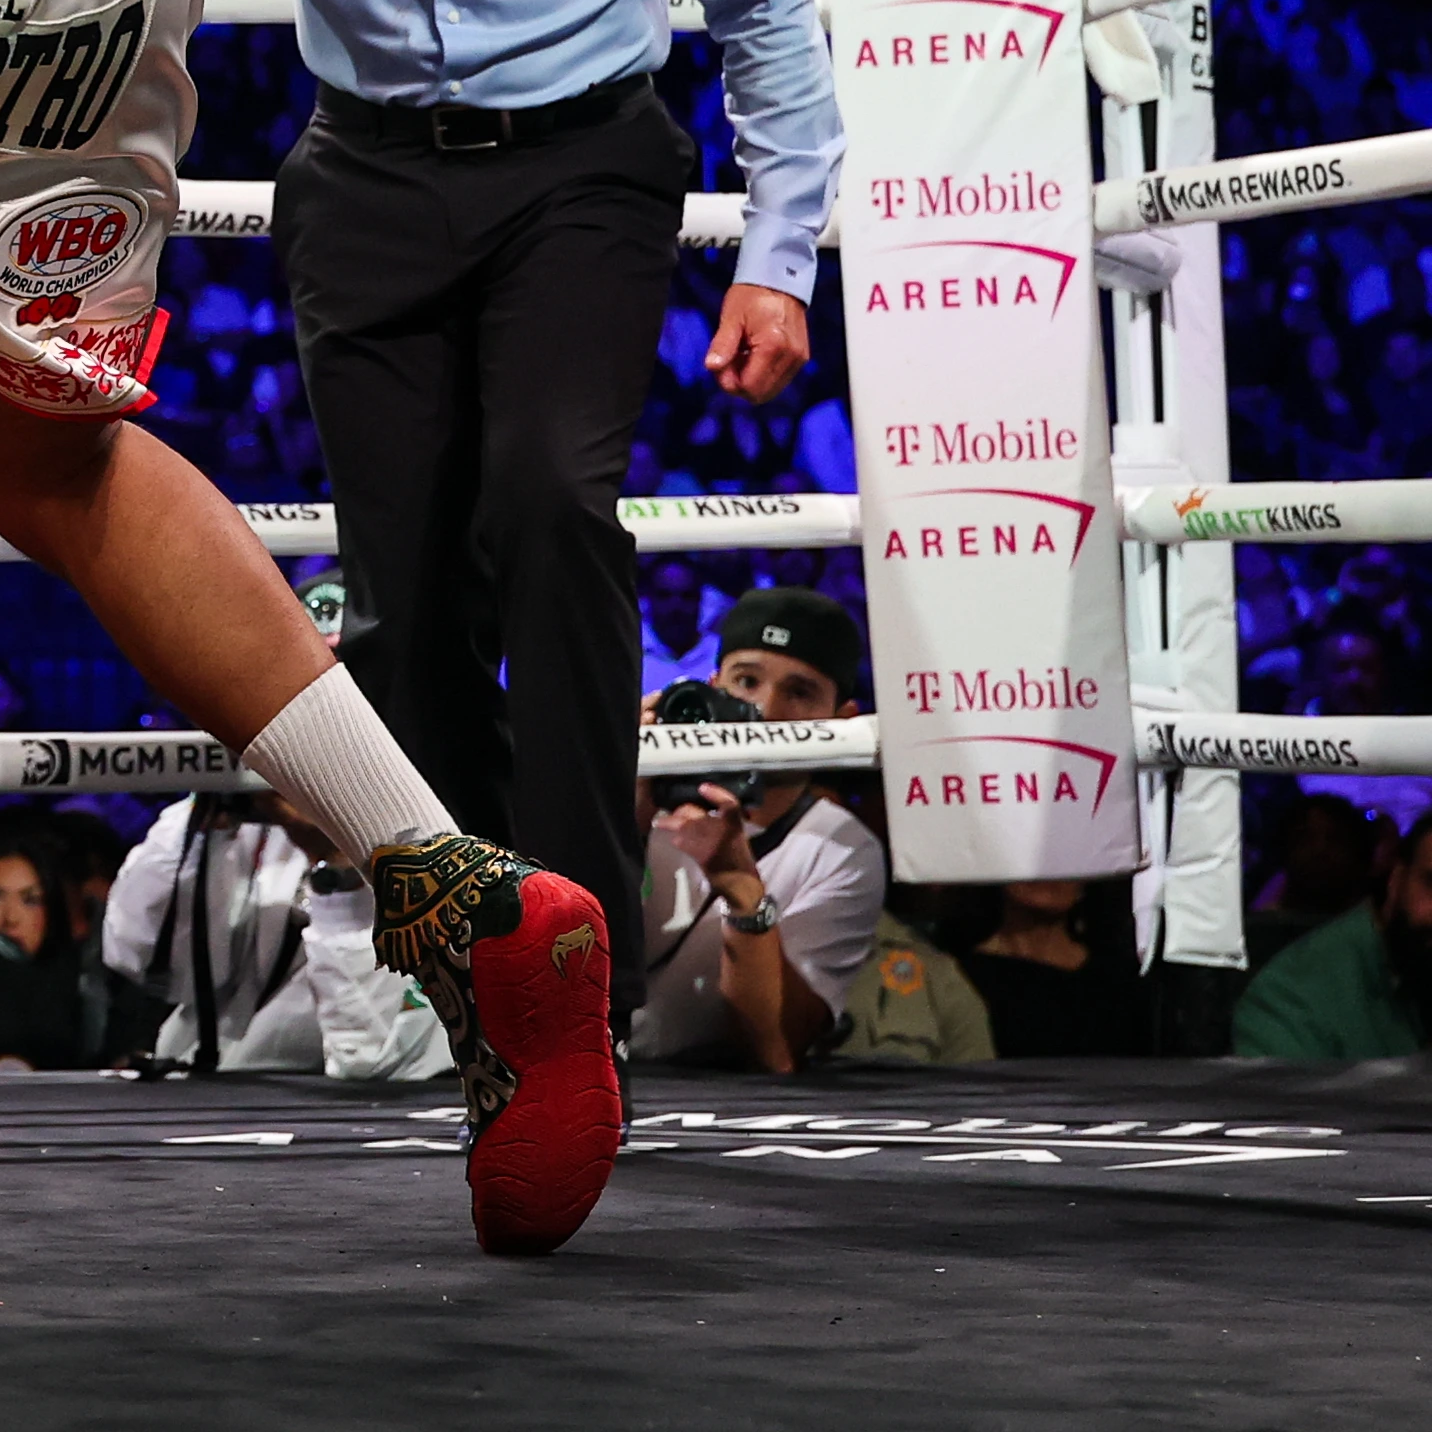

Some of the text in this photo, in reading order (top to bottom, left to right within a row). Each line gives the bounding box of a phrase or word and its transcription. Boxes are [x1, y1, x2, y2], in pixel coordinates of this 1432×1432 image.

[856, 30, 1024, 69] ARENA
[915, 171, 1062, 217] Mobile
[1168, 160, 1345, 212] MGM REWARDS
[17, 212, 128, 266] WBO
[0, 250, 120, 294] WORLD CHAMPION
[866, 274, 1036, 314] ARENA
[931, 418, 1078, 465] Mobile
[884, 523, 1056, 560] ARENA
[1183, 504, 1342, 540] DRAFTKINGS
[952, 667, 1099, 713] Mobile
[79, 746, 165, 775] MGM
[1179, 738, 1359, 768] MGM REWARDS
[905, 771, 1078, 807] ARENA
